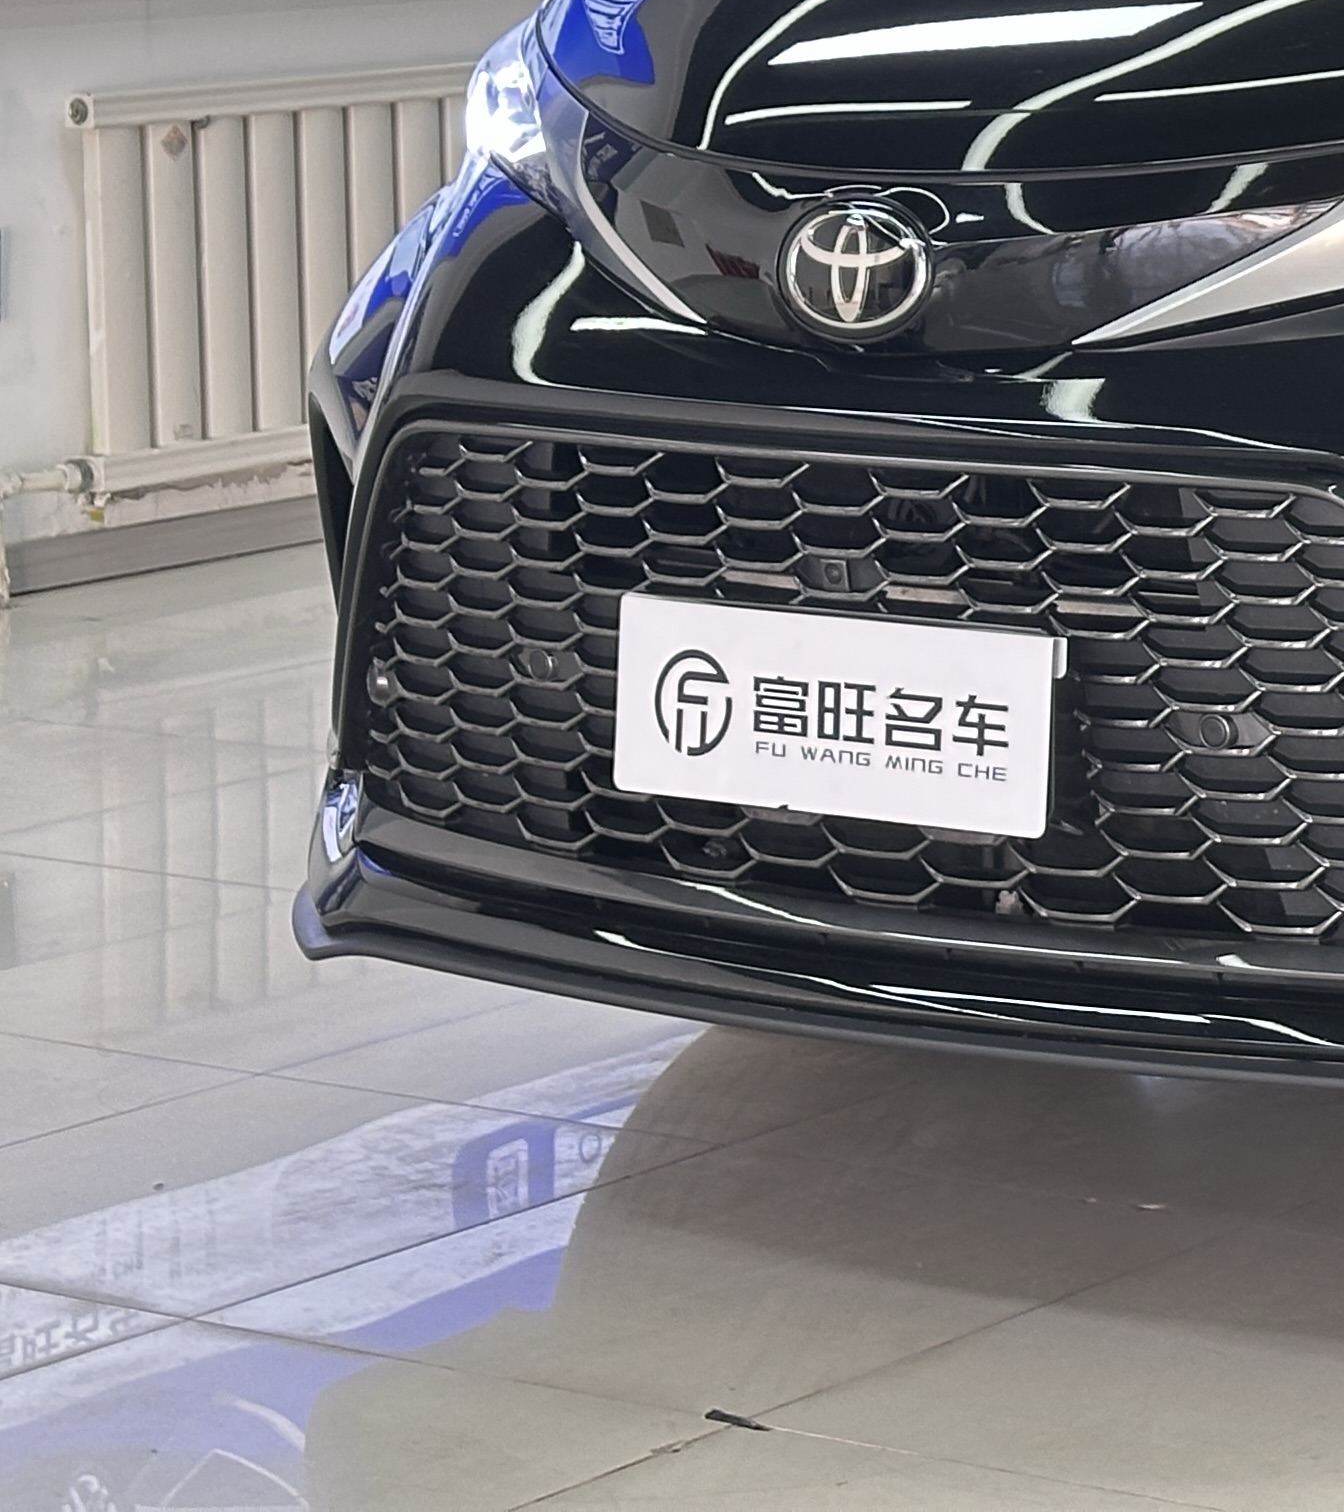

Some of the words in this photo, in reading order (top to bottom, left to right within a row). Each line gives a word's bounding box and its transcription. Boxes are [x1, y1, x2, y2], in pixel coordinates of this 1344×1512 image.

[752, 675, 1010, 757] 富旺名车
[754, 741, 786, 758] FU
[801, 745, 871, 767] WANG
[885, 755, 943, 775] MING
[957, 763, 1008, 782] CHE
